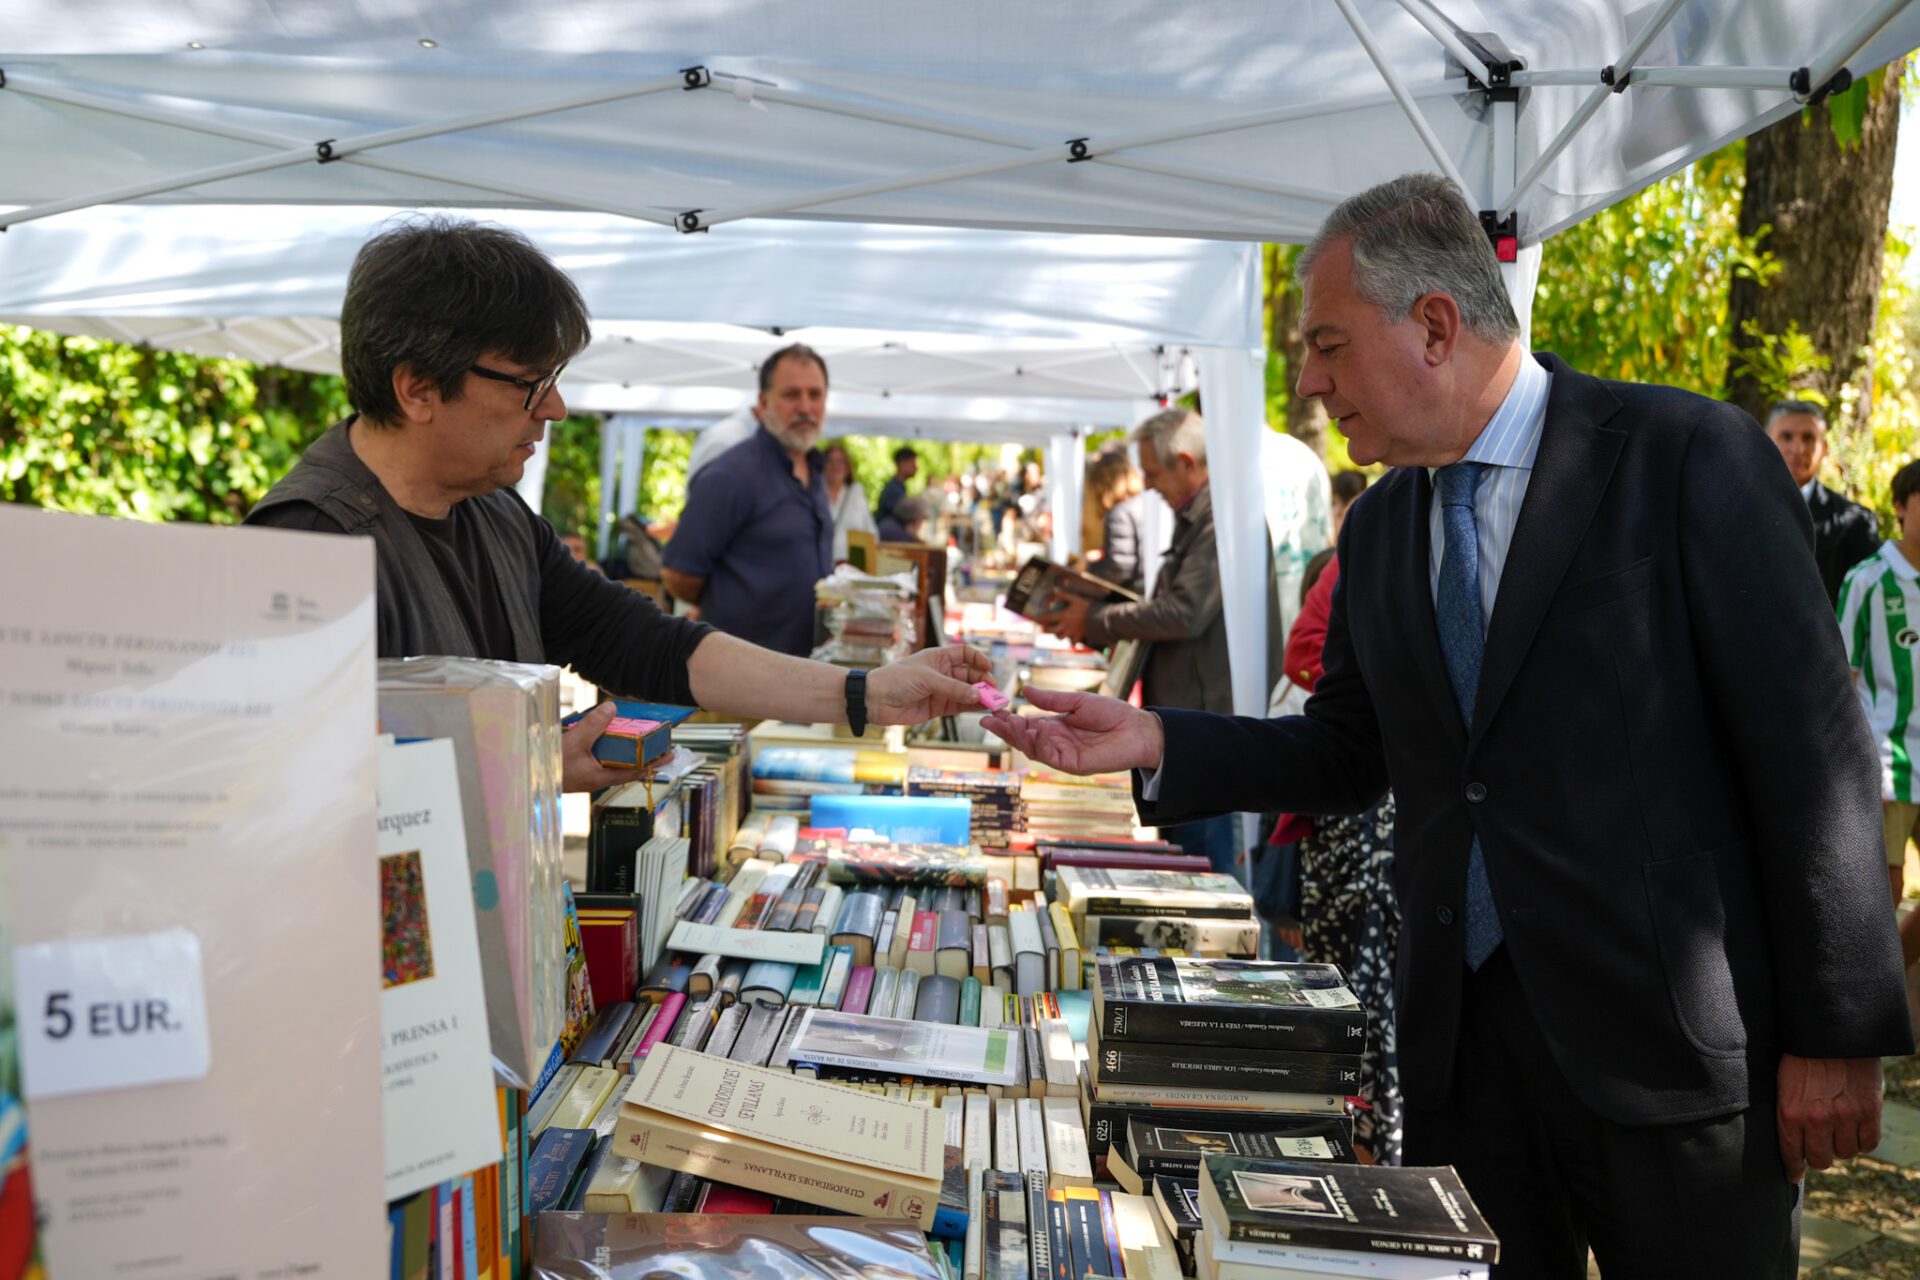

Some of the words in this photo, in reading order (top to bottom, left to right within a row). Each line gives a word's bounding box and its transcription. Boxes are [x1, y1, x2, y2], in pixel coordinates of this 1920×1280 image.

[43, 990, 75, 1040] 5
[88, 1001, 183, 1038] EUR.
[1112, 1006, 1124, 1034] 730/1
[1180, 1020, 1208, 1029] ALEGRÍA
[391, 1017, 449, 1047] PRENSA
[1105, 1049, 1118, 1073] 466
[1204, 1064, 1224, 1072] AIRES
[1224, 1065, 1237, 1073] LOS
[707, 1068, 741, 1119] CURIOSIDADES
[737, 1079, 766, 1121] SEVILLANAS
[1164, 1091, 1203, 1100] GRANDES
[1205, 1093, 1249, 1102] ALMUDENA
[1096, 1120, 1109, 1142] 625
[743, 1161, 798, 1185] SEVILLANAS
[798, 1174, 865, 1200] CURIOSIDADES
[1370, 1239, 1402, 1250] CIENCIA
[1401, 1242, 1413, 1250] LA
